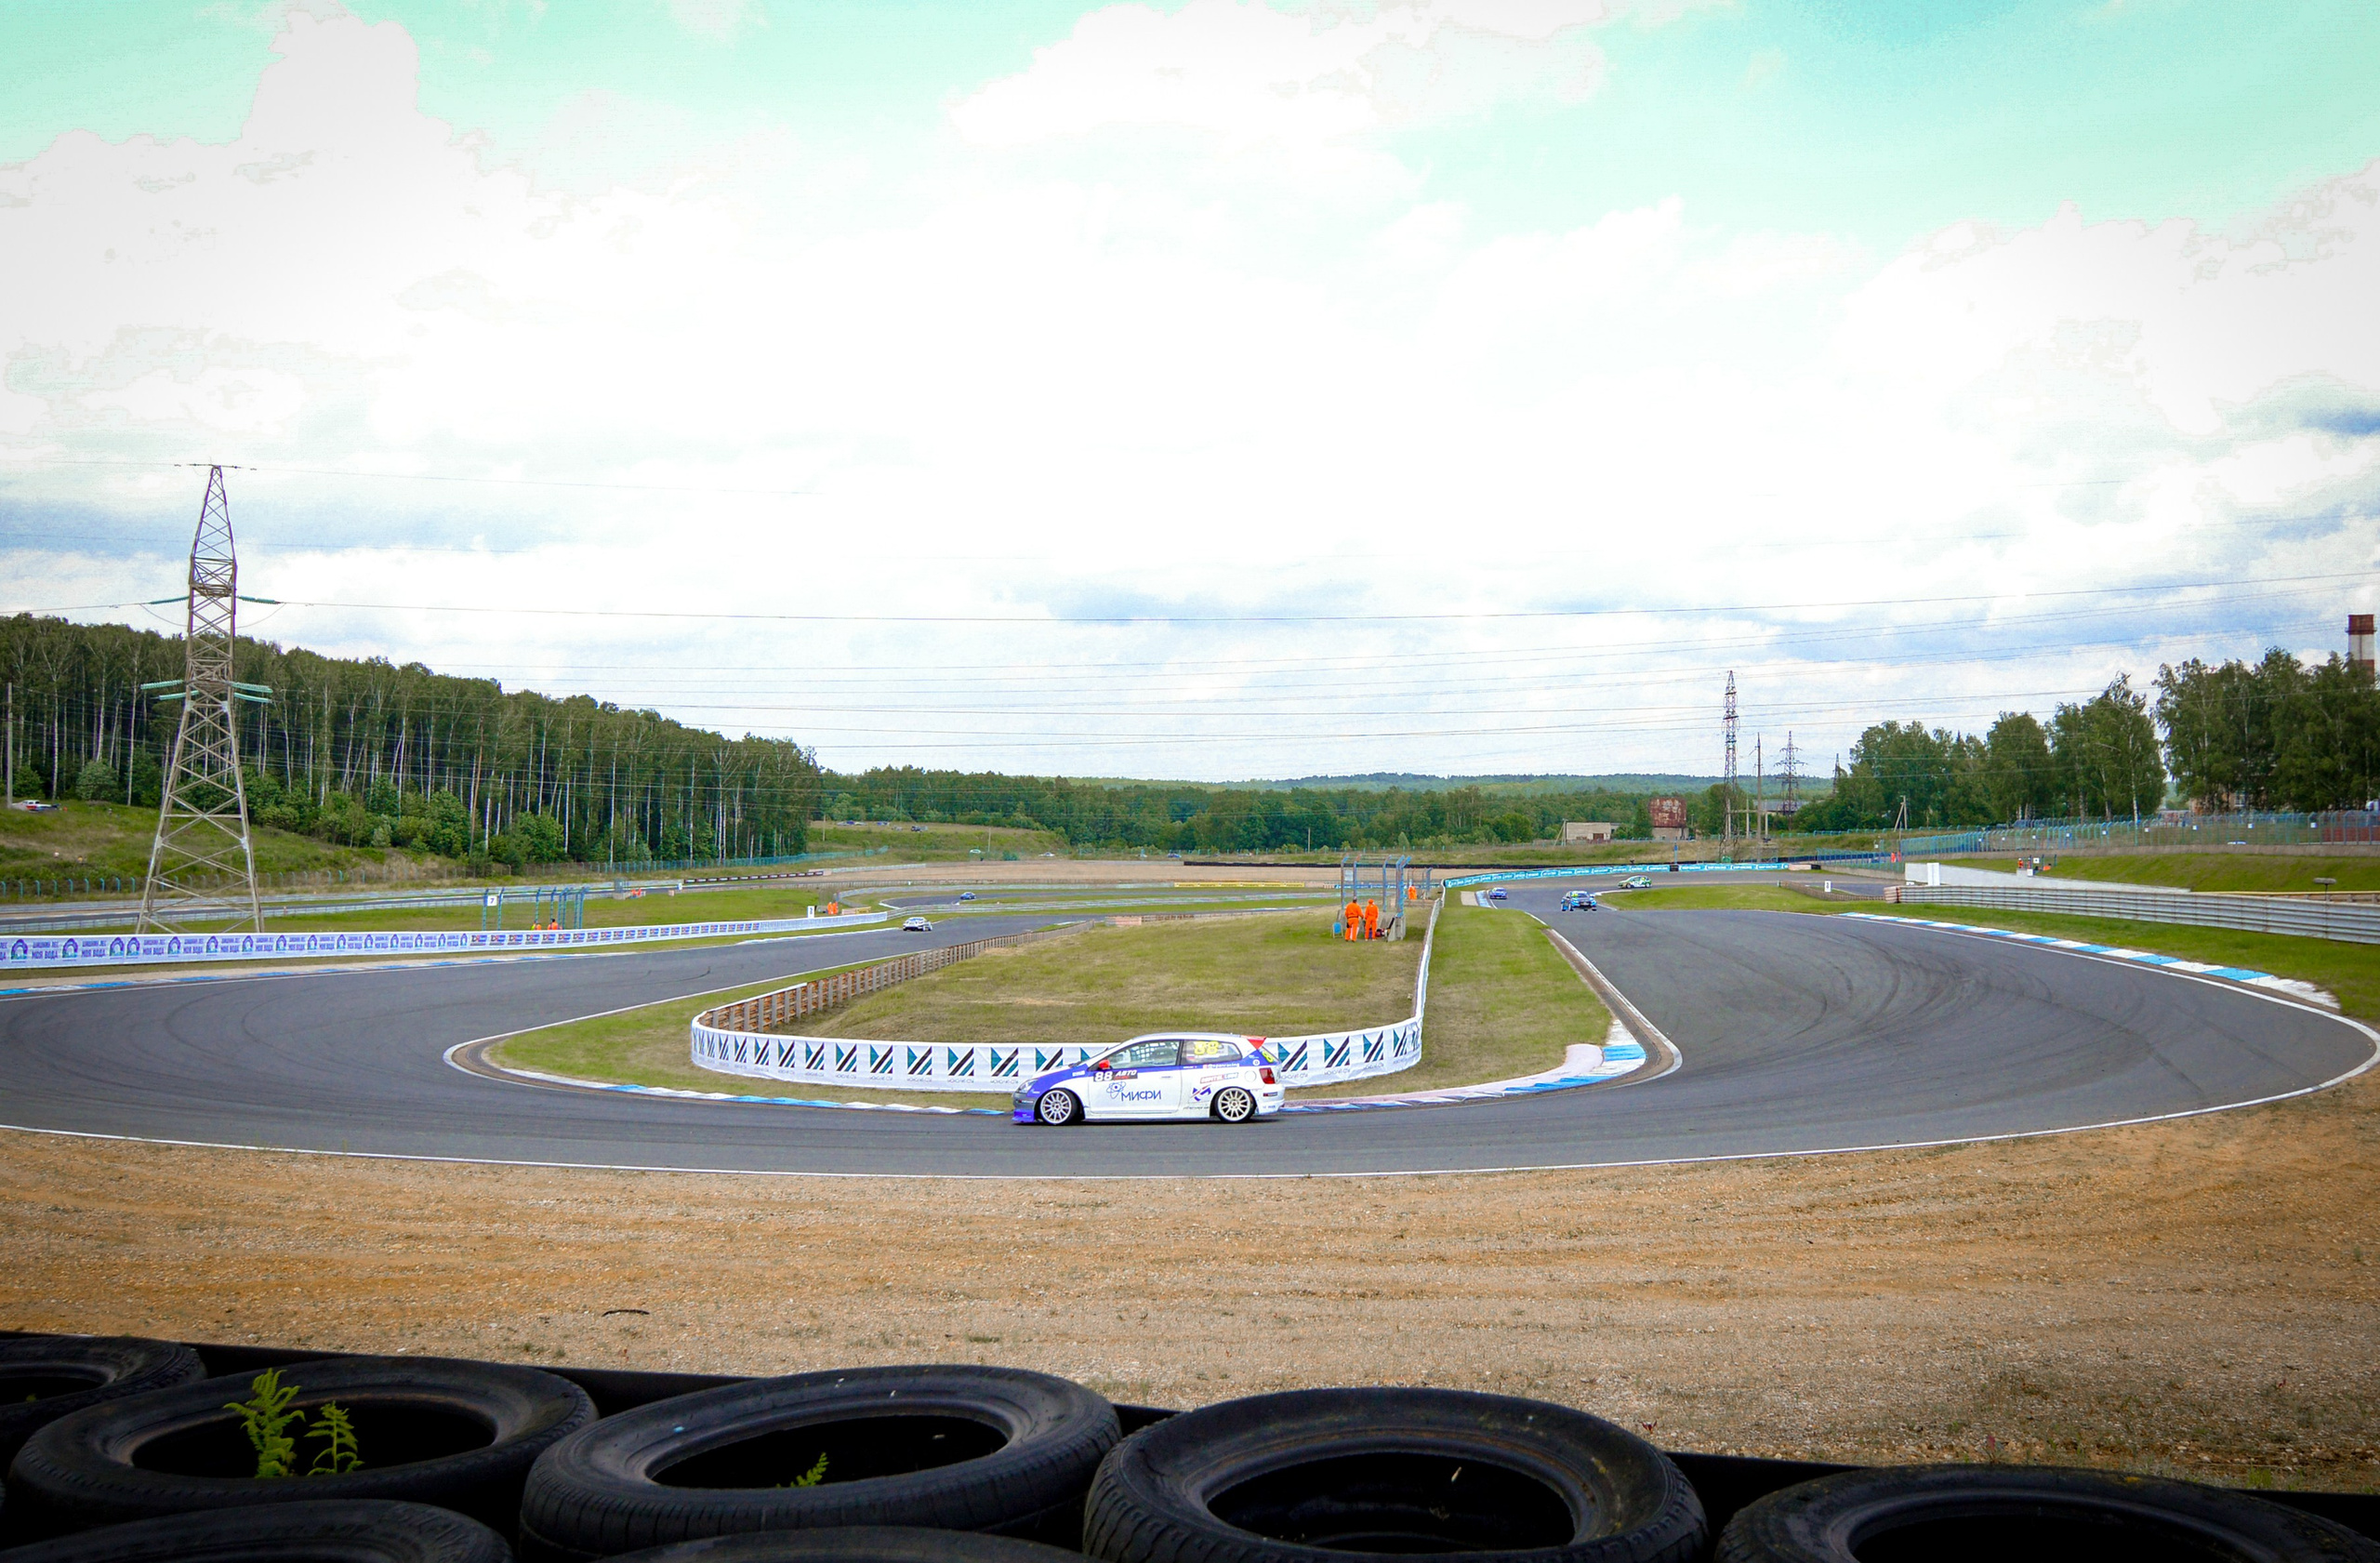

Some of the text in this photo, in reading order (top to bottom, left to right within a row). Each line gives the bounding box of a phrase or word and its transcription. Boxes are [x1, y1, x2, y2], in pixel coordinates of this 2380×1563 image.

[1194, 1040, 1219, 1055] 88
[1094, 1071, 1113, 1081] 88
[1121, 1090, 1161, 1101] МИФИ
